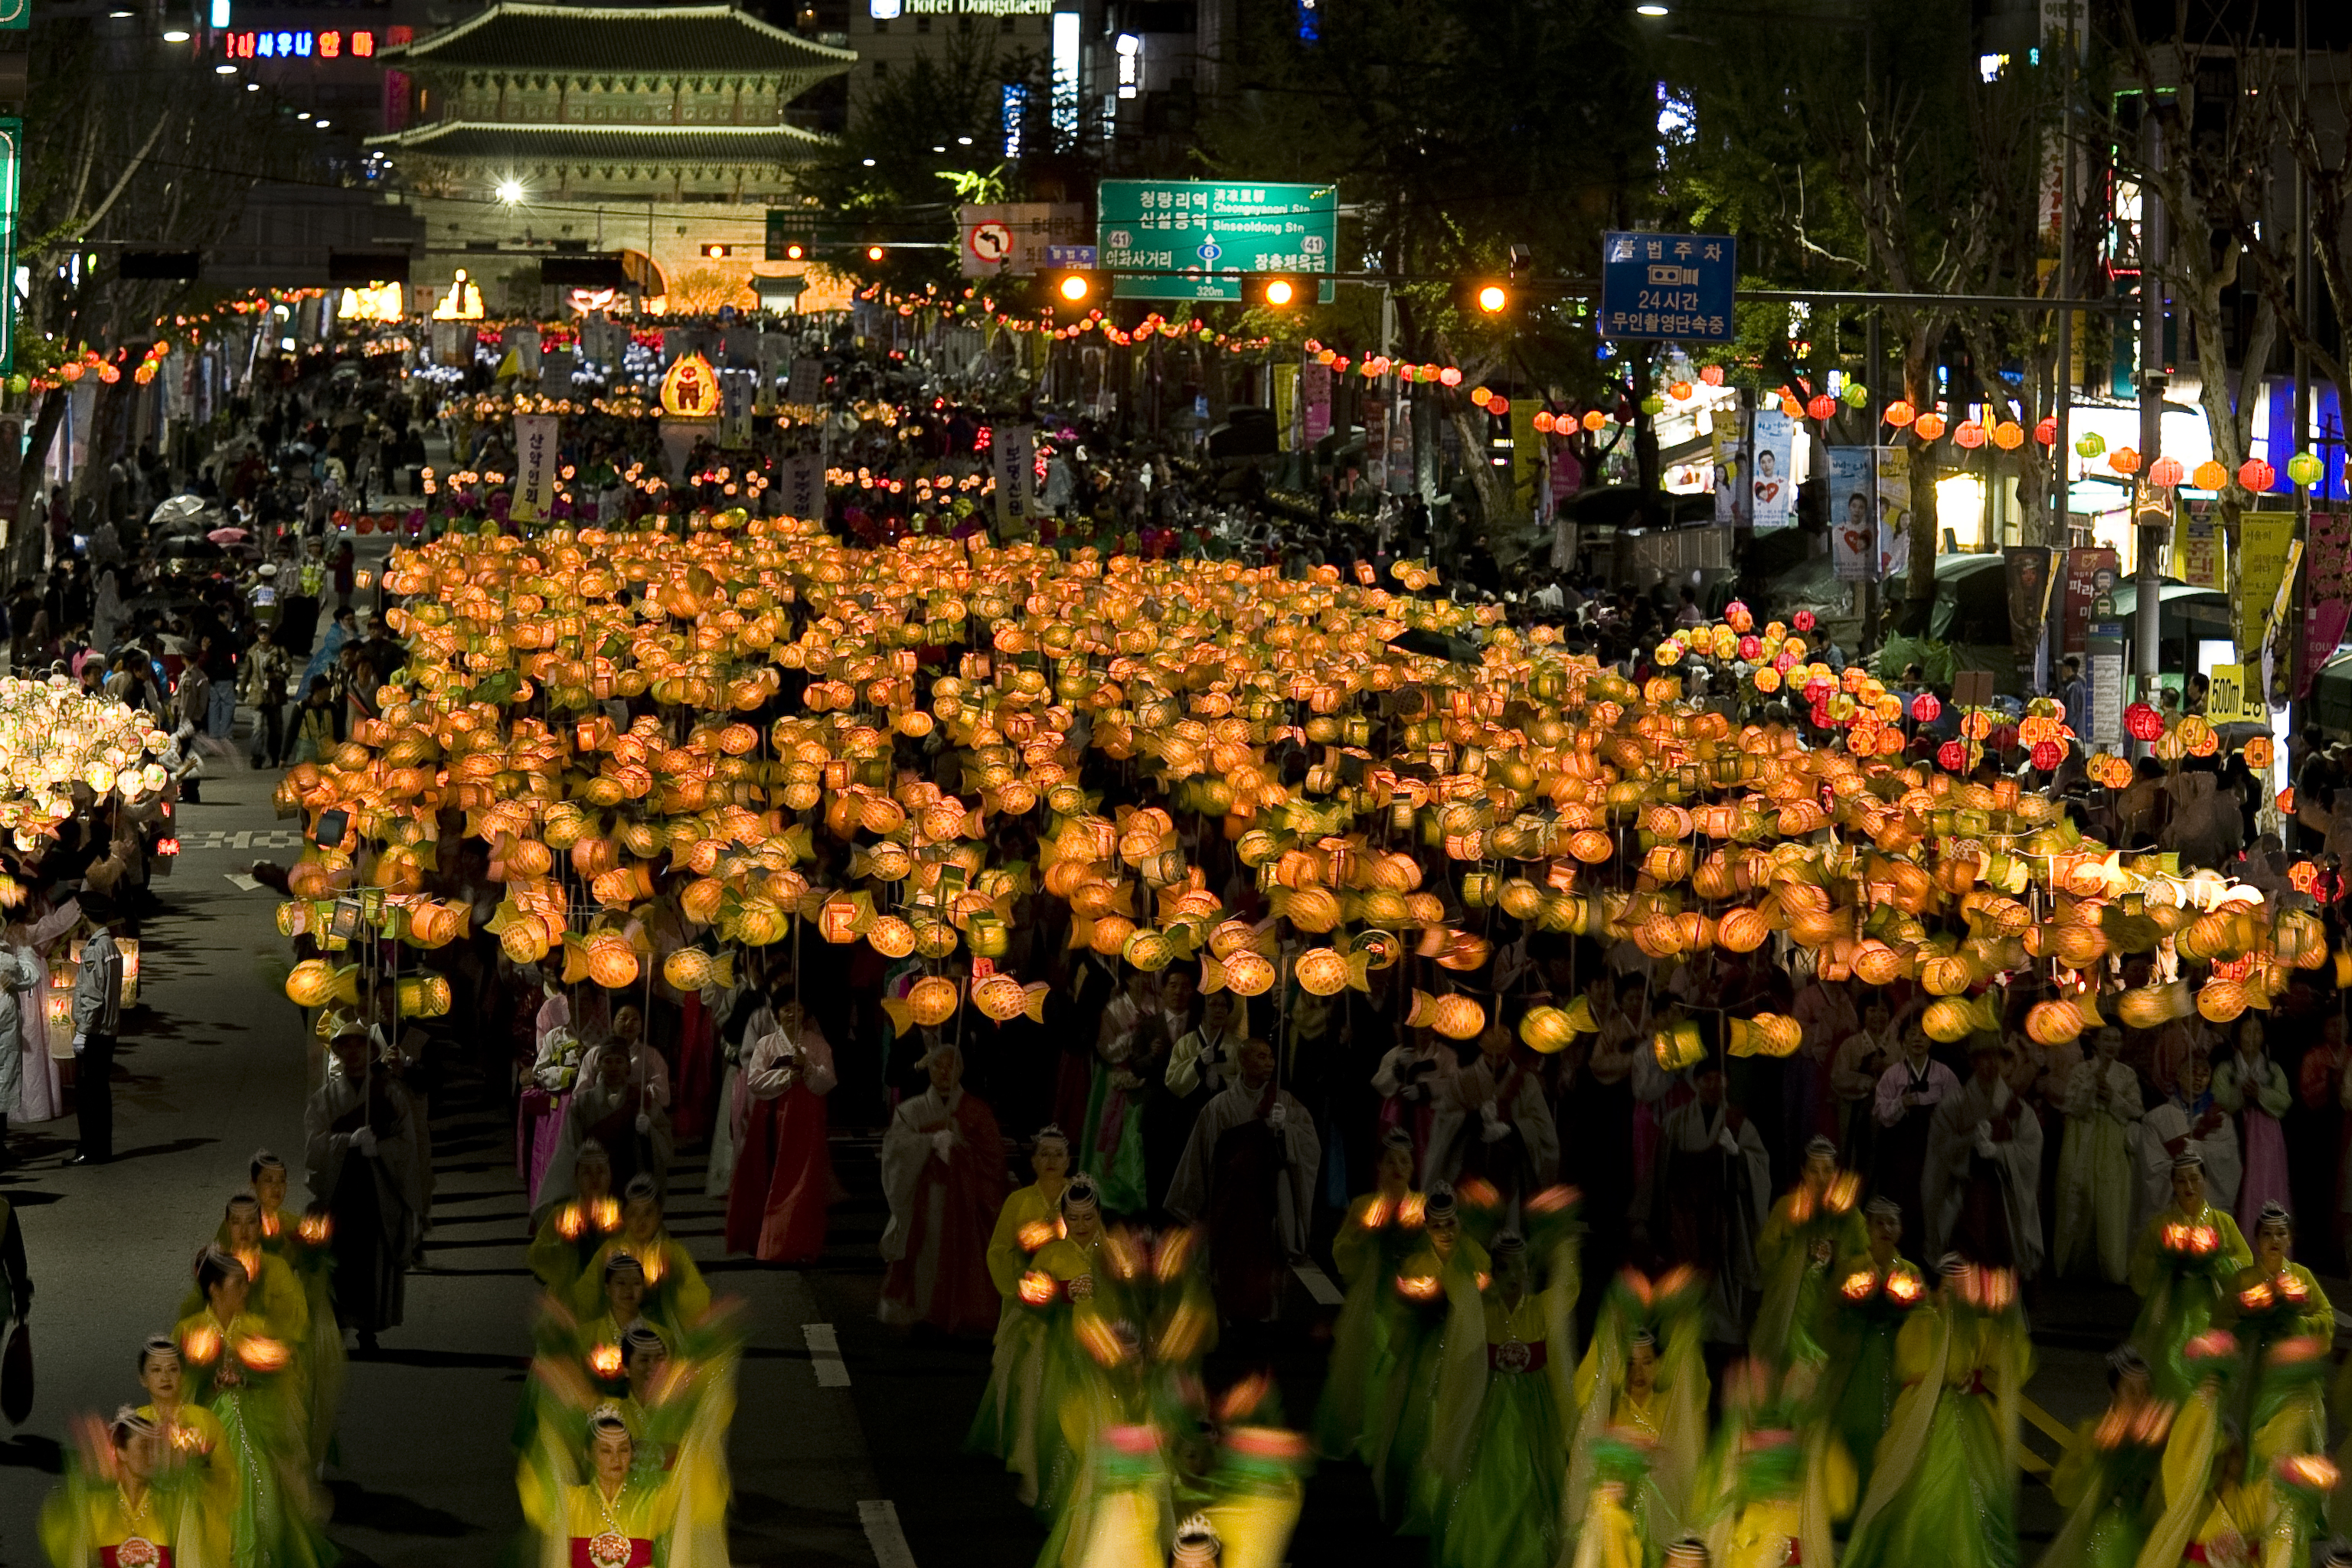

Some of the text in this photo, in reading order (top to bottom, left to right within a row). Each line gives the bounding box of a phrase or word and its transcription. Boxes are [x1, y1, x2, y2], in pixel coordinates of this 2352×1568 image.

[905, 0, 953, 14] Hotel
[256, 31, 313, 57] 사우나
[1140, 191, 1207, 210] 청량리역
[1292, 204, 1310, 214] Stn
[1139, 212, 1207, 230] 신설동역
[1213, 220, 1305, 235] Sinseoldong Stn
[1112, 232, 1126, 246] 41
[1306, 238, 1320, 251] 41
[1106, 250, 1172, 268] 이화사거리
[1619, 240, 1723, 262] 불법주차
[1255, 253, 1325, 273] 장충체육관
[1196, 286, 1223, 297] 320m
[1638, 290, 1699, 311] 24시간
[1612, 312, 1724, 335] 무인촬영단속중
[525, 434, 544, 505] 산악인회
[2309, 642, 2333, 652] EOUL
[2211, 678, 2239, 714] 500m
